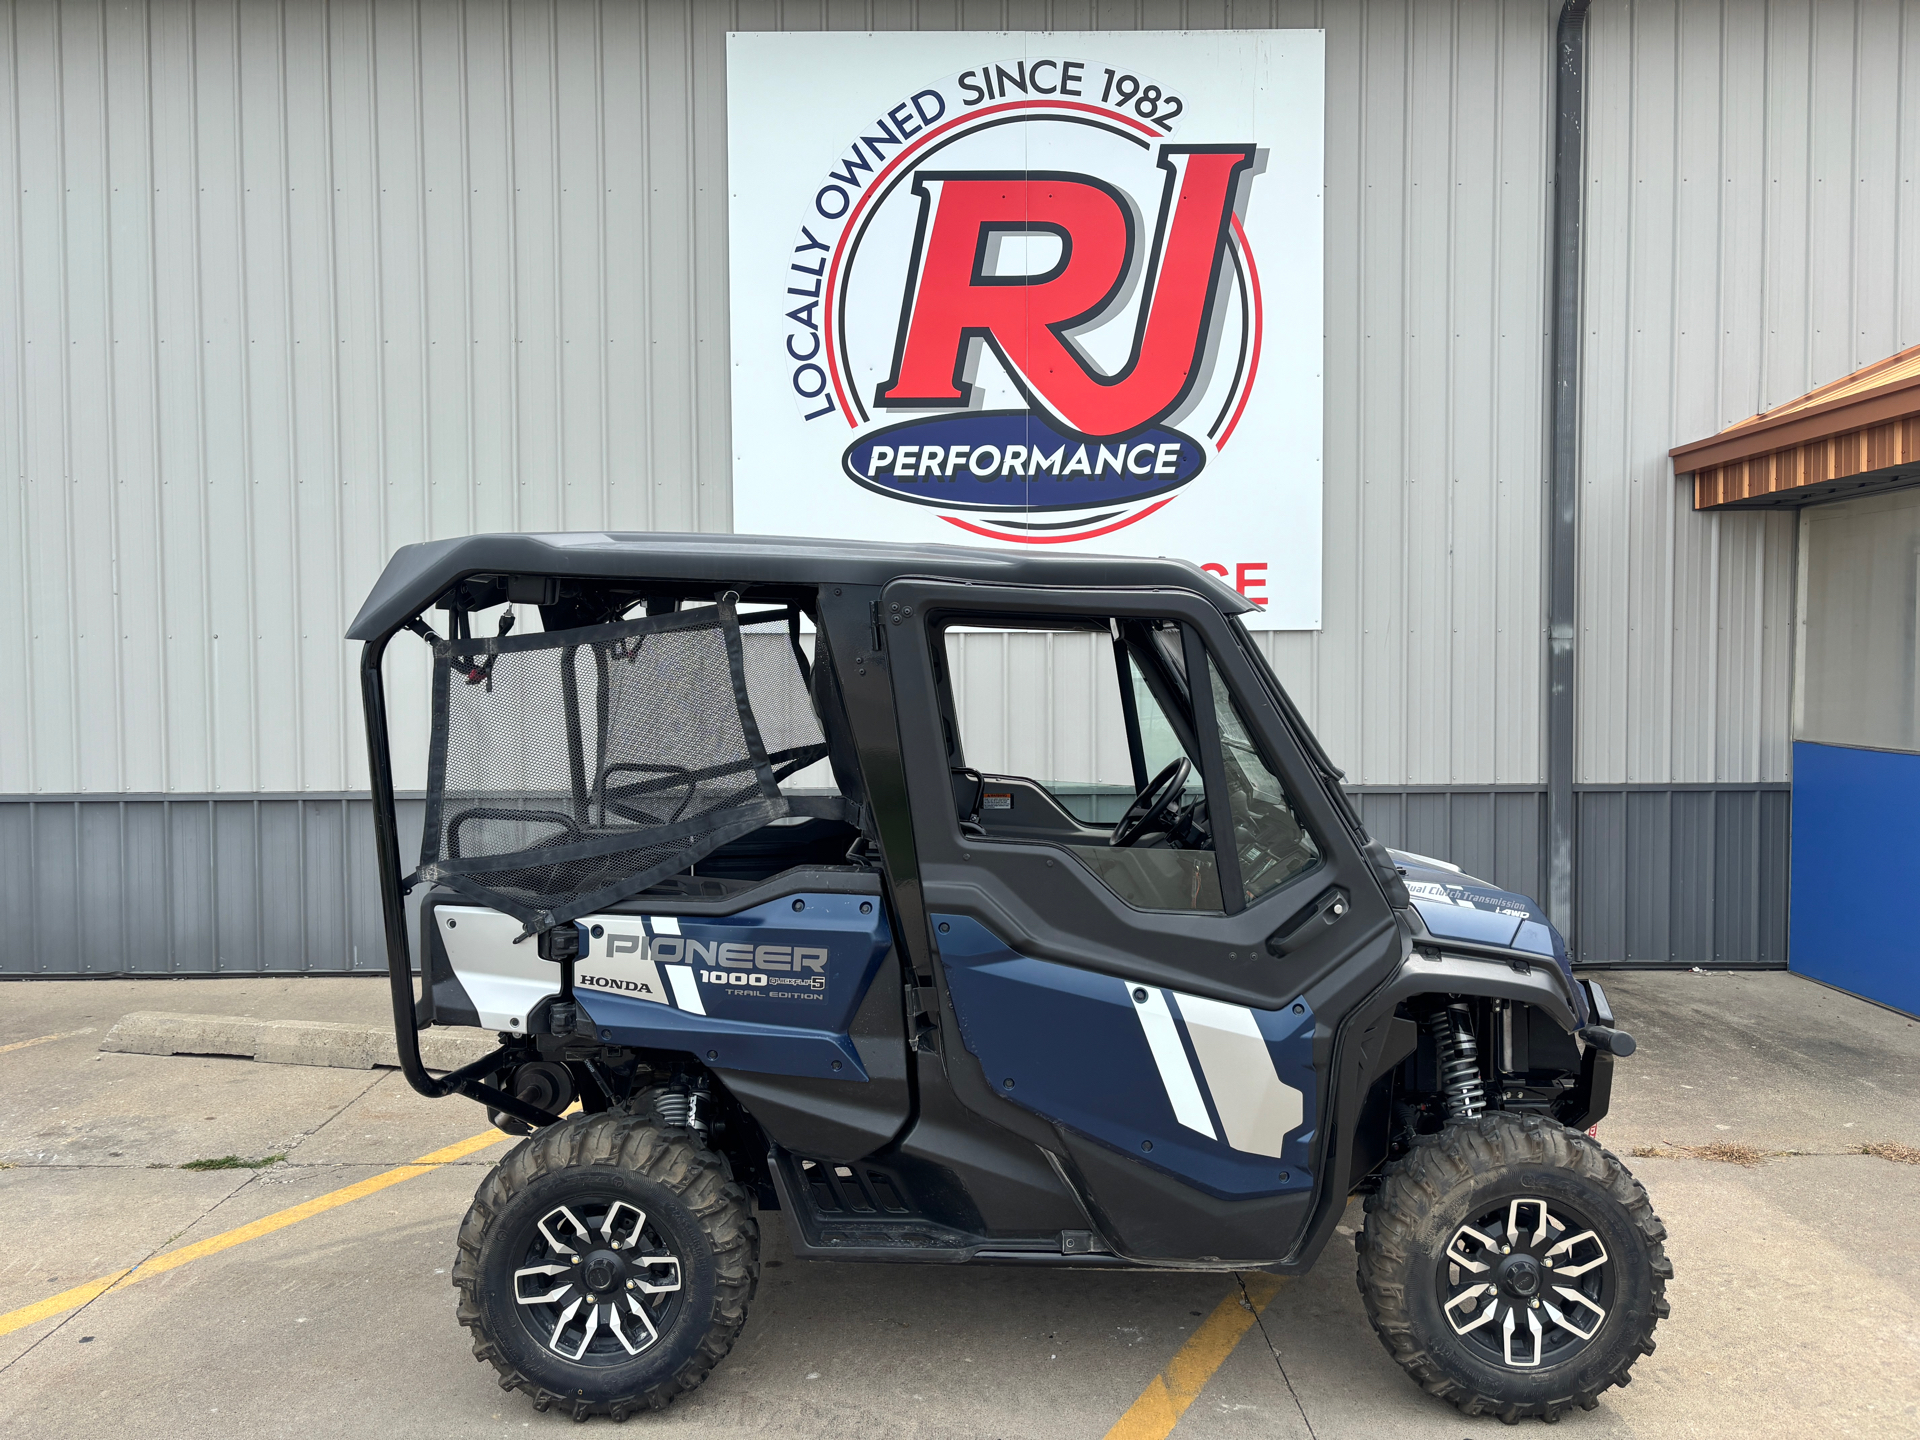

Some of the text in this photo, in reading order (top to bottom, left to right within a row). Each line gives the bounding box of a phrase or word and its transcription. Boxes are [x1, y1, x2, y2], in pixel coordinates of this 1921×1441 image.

[784, 60, 1184, 421] LOCALLY OWNED SINCE 1982
[874, 143, 1257, 443] RJ
[867, 443, 1182, 478] PERFORMANCE
[1428, 886, 1462, 899] Clutch
[1463, 891, 1525, 911] Transmission
[606, 933, 828, 973] PIONEER
[580, 974, 653, 994] HONDA
[700, 970, 768, 987] 1000
[725, 989, 824, 1000] TRAIL EDITION
